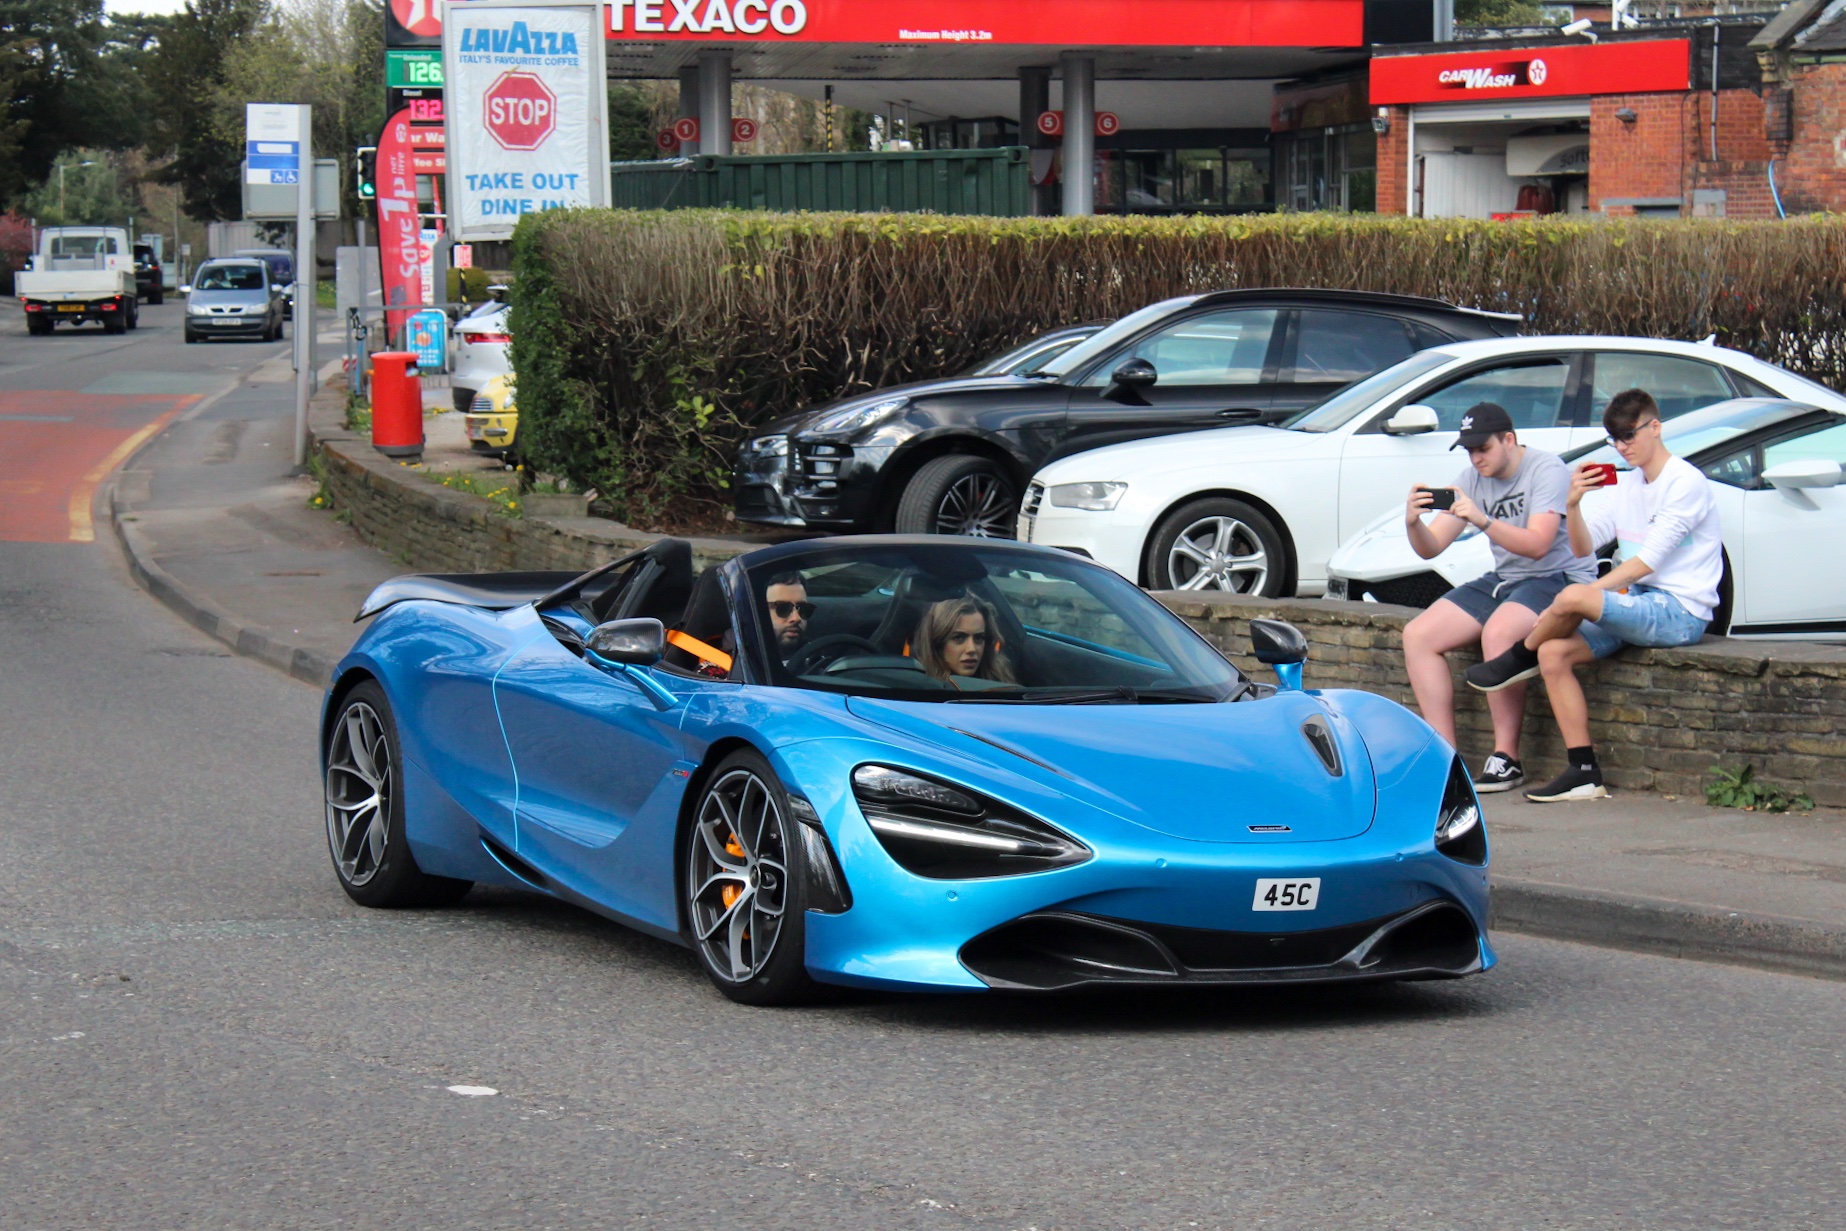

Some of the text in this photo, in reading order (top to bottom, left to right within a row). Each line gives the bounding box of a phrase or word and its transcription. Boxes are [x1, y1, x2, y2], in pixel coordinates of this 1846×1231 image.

[604, 0, 808, 35] TEXACO
[459, 21, 579, 55] LAVAZZA
[899, 29, 993, 41] Maximum Height 3.2m
[459, 54, 579, 67] ITALY'S FAVOURITE COFFEE
[408, 61, 445, 83] 126.
[408, 99, 446, 121] 132.
[490, 97, 550, 126] STOP
[682, 123, 689, 135] 1
[741, 124, 750, 135] 2
[1044, 117, 1054, 128] 5
[1103, 118, 1113, 129] 6
[410, 132, 445, 143] ar Wa
[663, 134, 671, 145] 3
[465, 172, 579, 191] TAKE OUT
[481, 198, 565, 216] DINE IN
[379, 177, 420, 278] Save 1p
[1483, 492, 1525, 519] VANS
[1264, 883, 1312, 907] 45C
